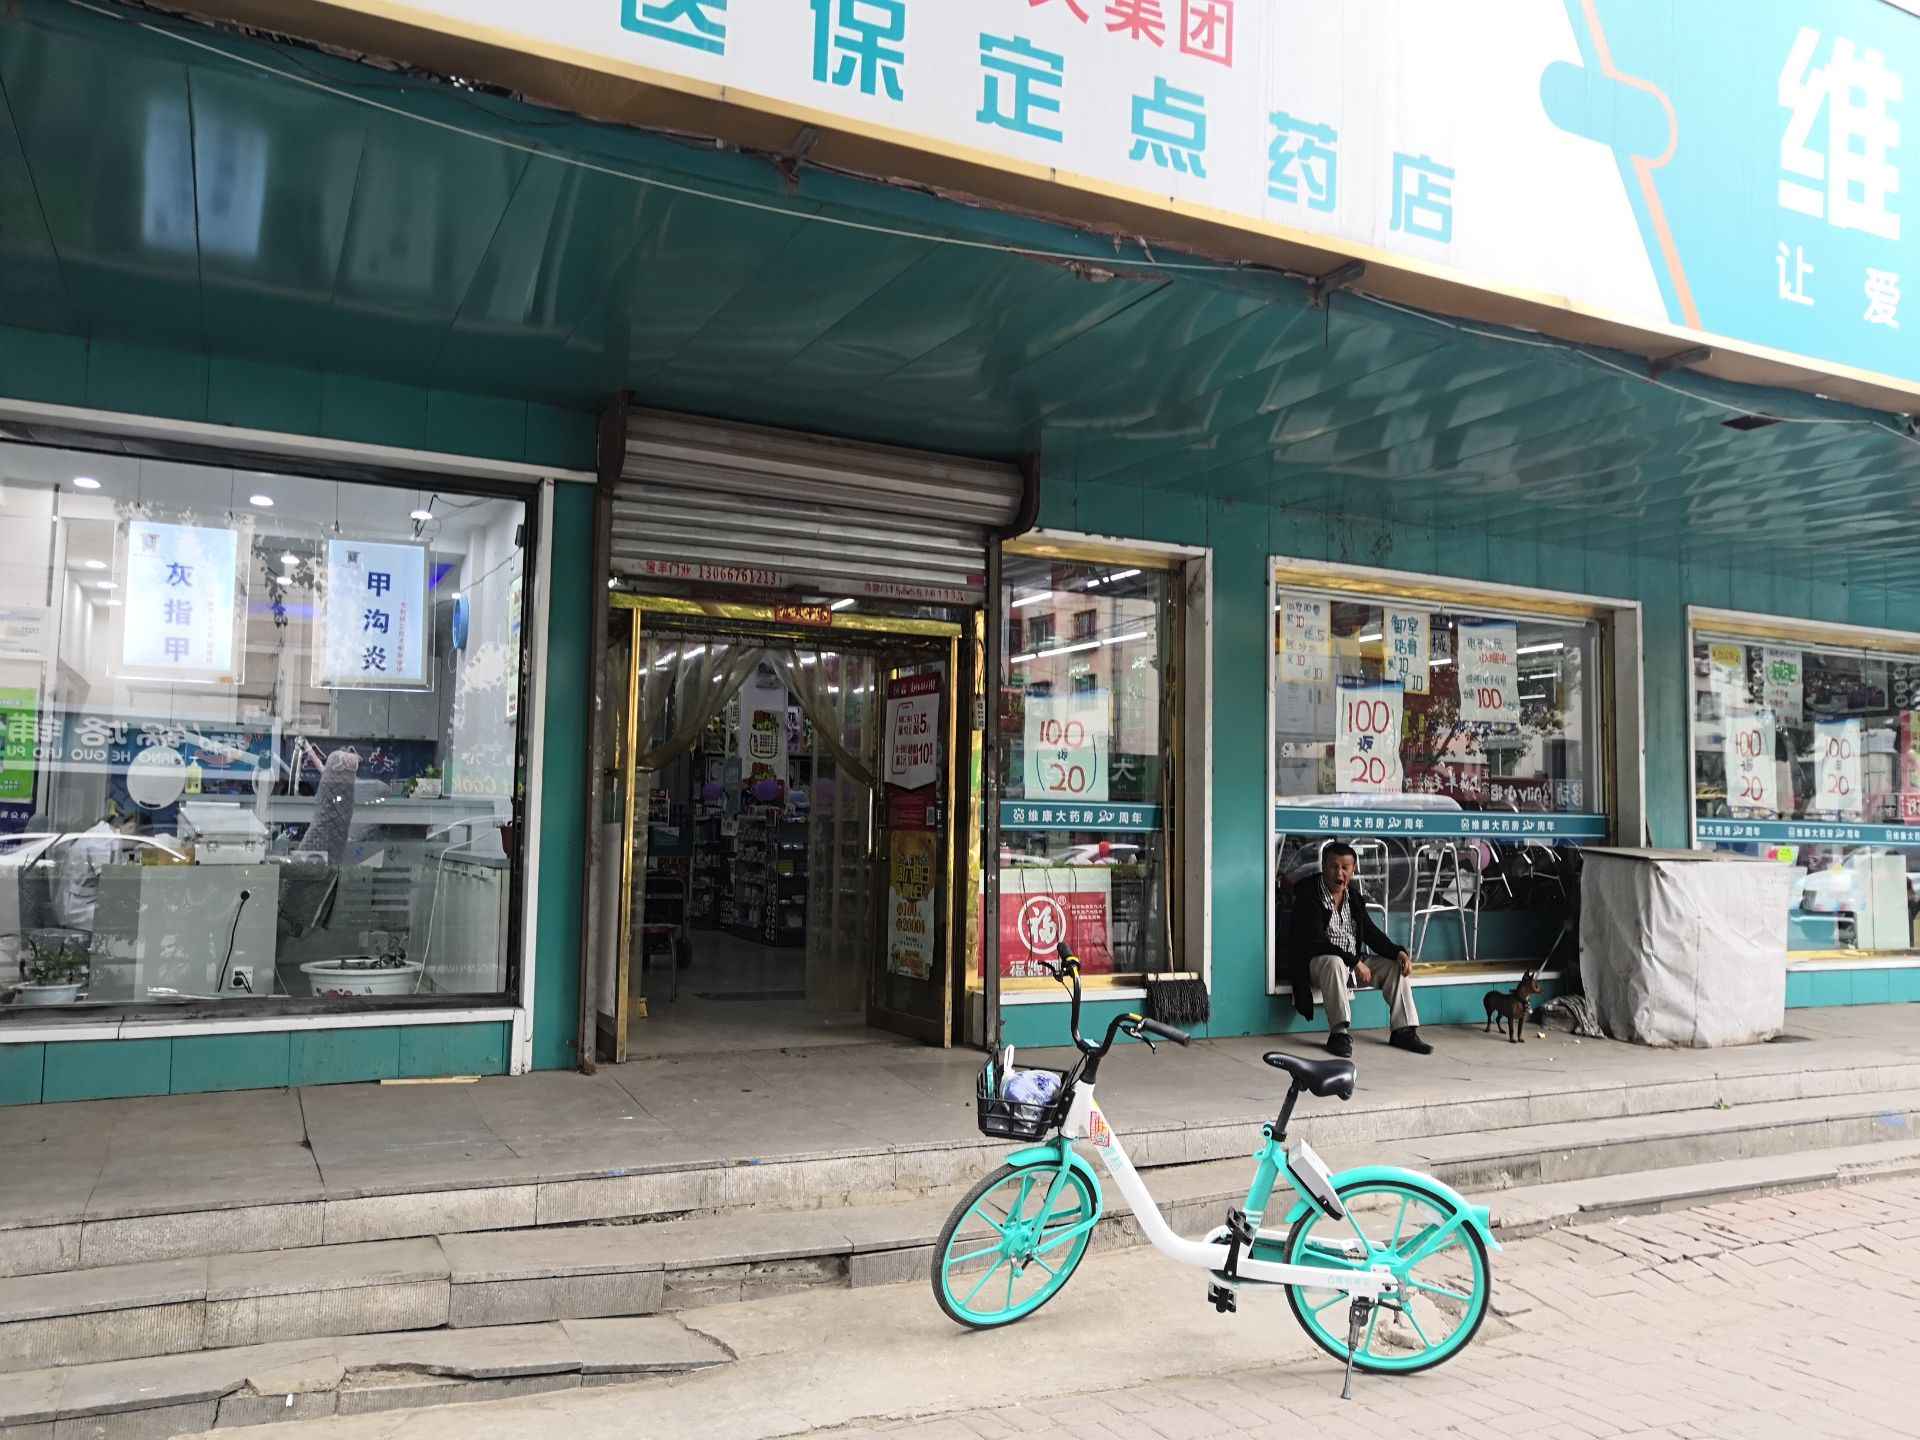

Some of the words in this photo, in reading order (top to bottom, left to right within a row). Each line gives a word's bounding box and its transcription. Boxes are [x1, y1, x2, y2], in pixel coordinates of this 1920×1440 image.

[1777, 25, 1900, 241] 维
[165, 561, 194, 662] 灰指甲
[361, 571, 391, 672] 甲沟炎
[1477, 688, 1503, 710] 100
[1347, 700, 1390, 734] 100
[1039, 719, 1085, 748] 100
[1049, 762, 1087, 793] 20
[1349, 756, 1386, 784] 20
